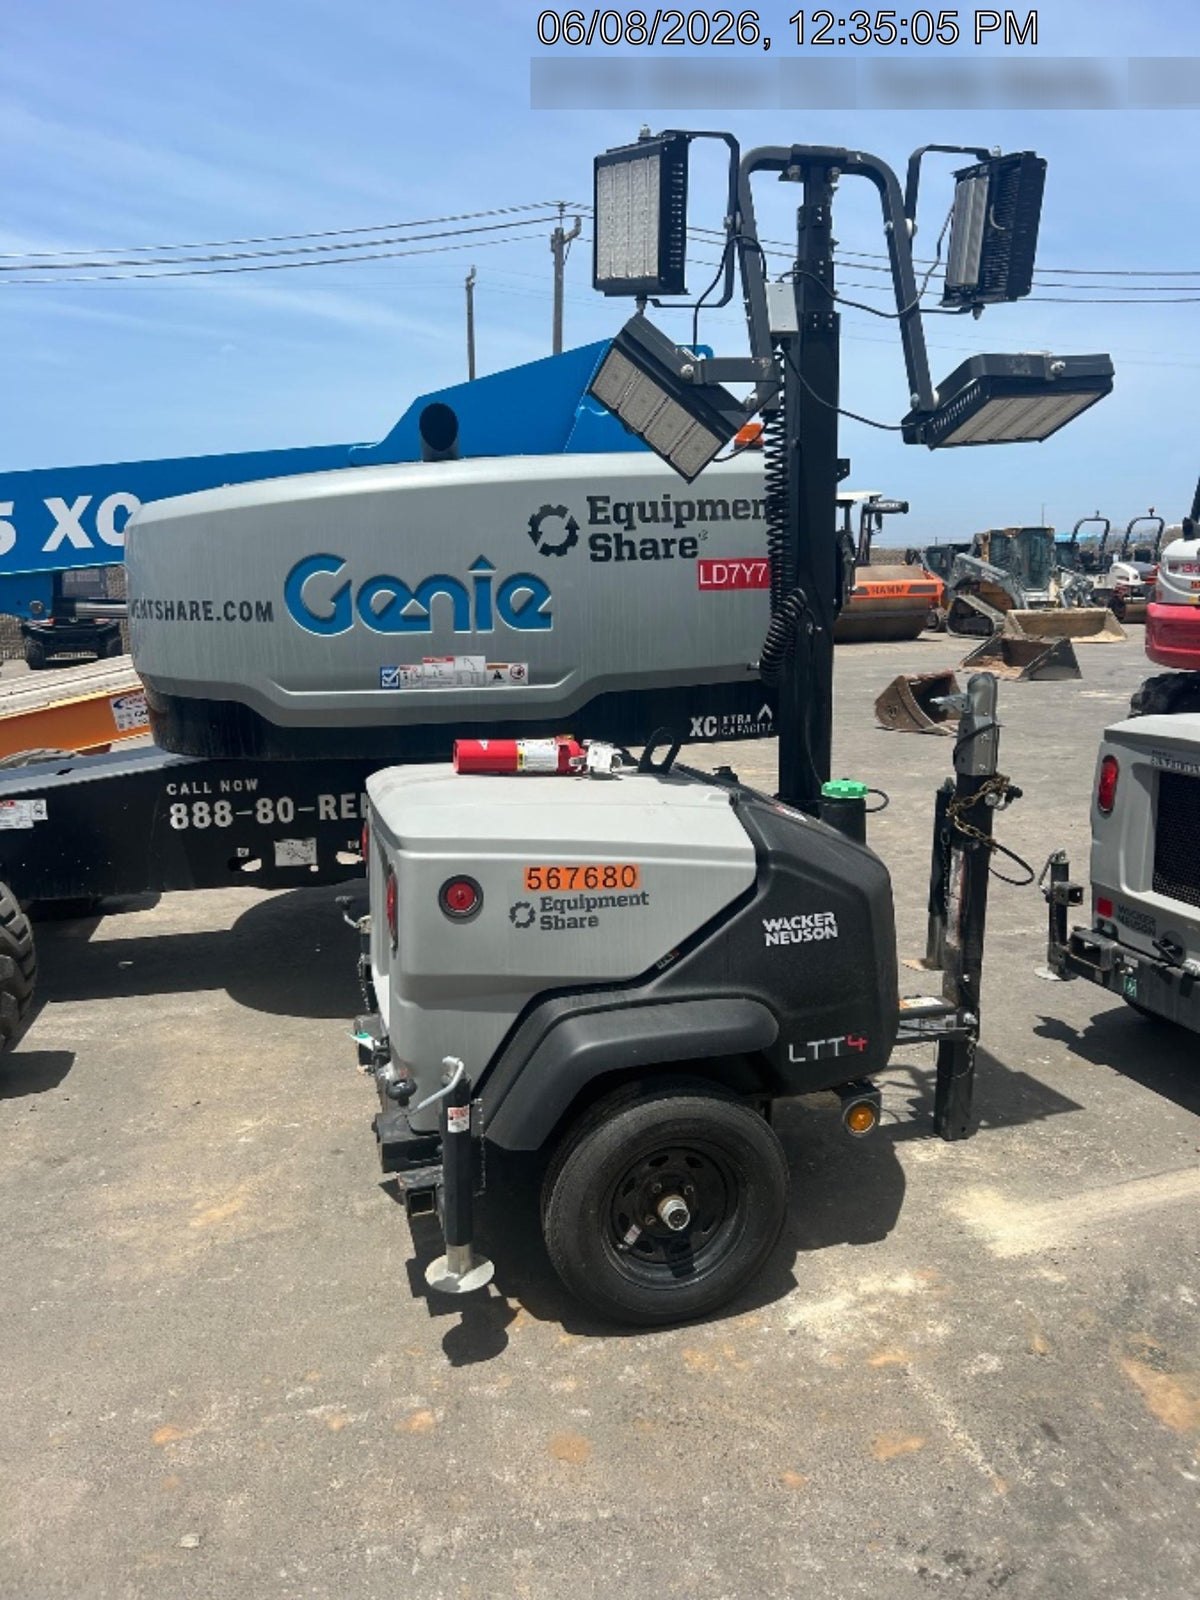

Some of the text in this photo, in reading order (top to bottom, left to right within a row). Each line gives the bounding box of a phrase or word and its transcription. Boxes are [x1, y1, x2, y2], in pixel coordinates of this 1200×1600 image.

[284, 553, 554, 637] Genie
[690, 714, 752, 737] XC XTRA
[166, 778, 259, 796] CALL NOW
[526, 865, 637, 890] 567680
[540, 891, 650, 914] Equipment
[540, 915, 600, 931] Share
[762, 911, 837, 933] WACKER
[764, 925, 839, 946] NEUSON
[788, 1034, 868, 1063] LTT4
